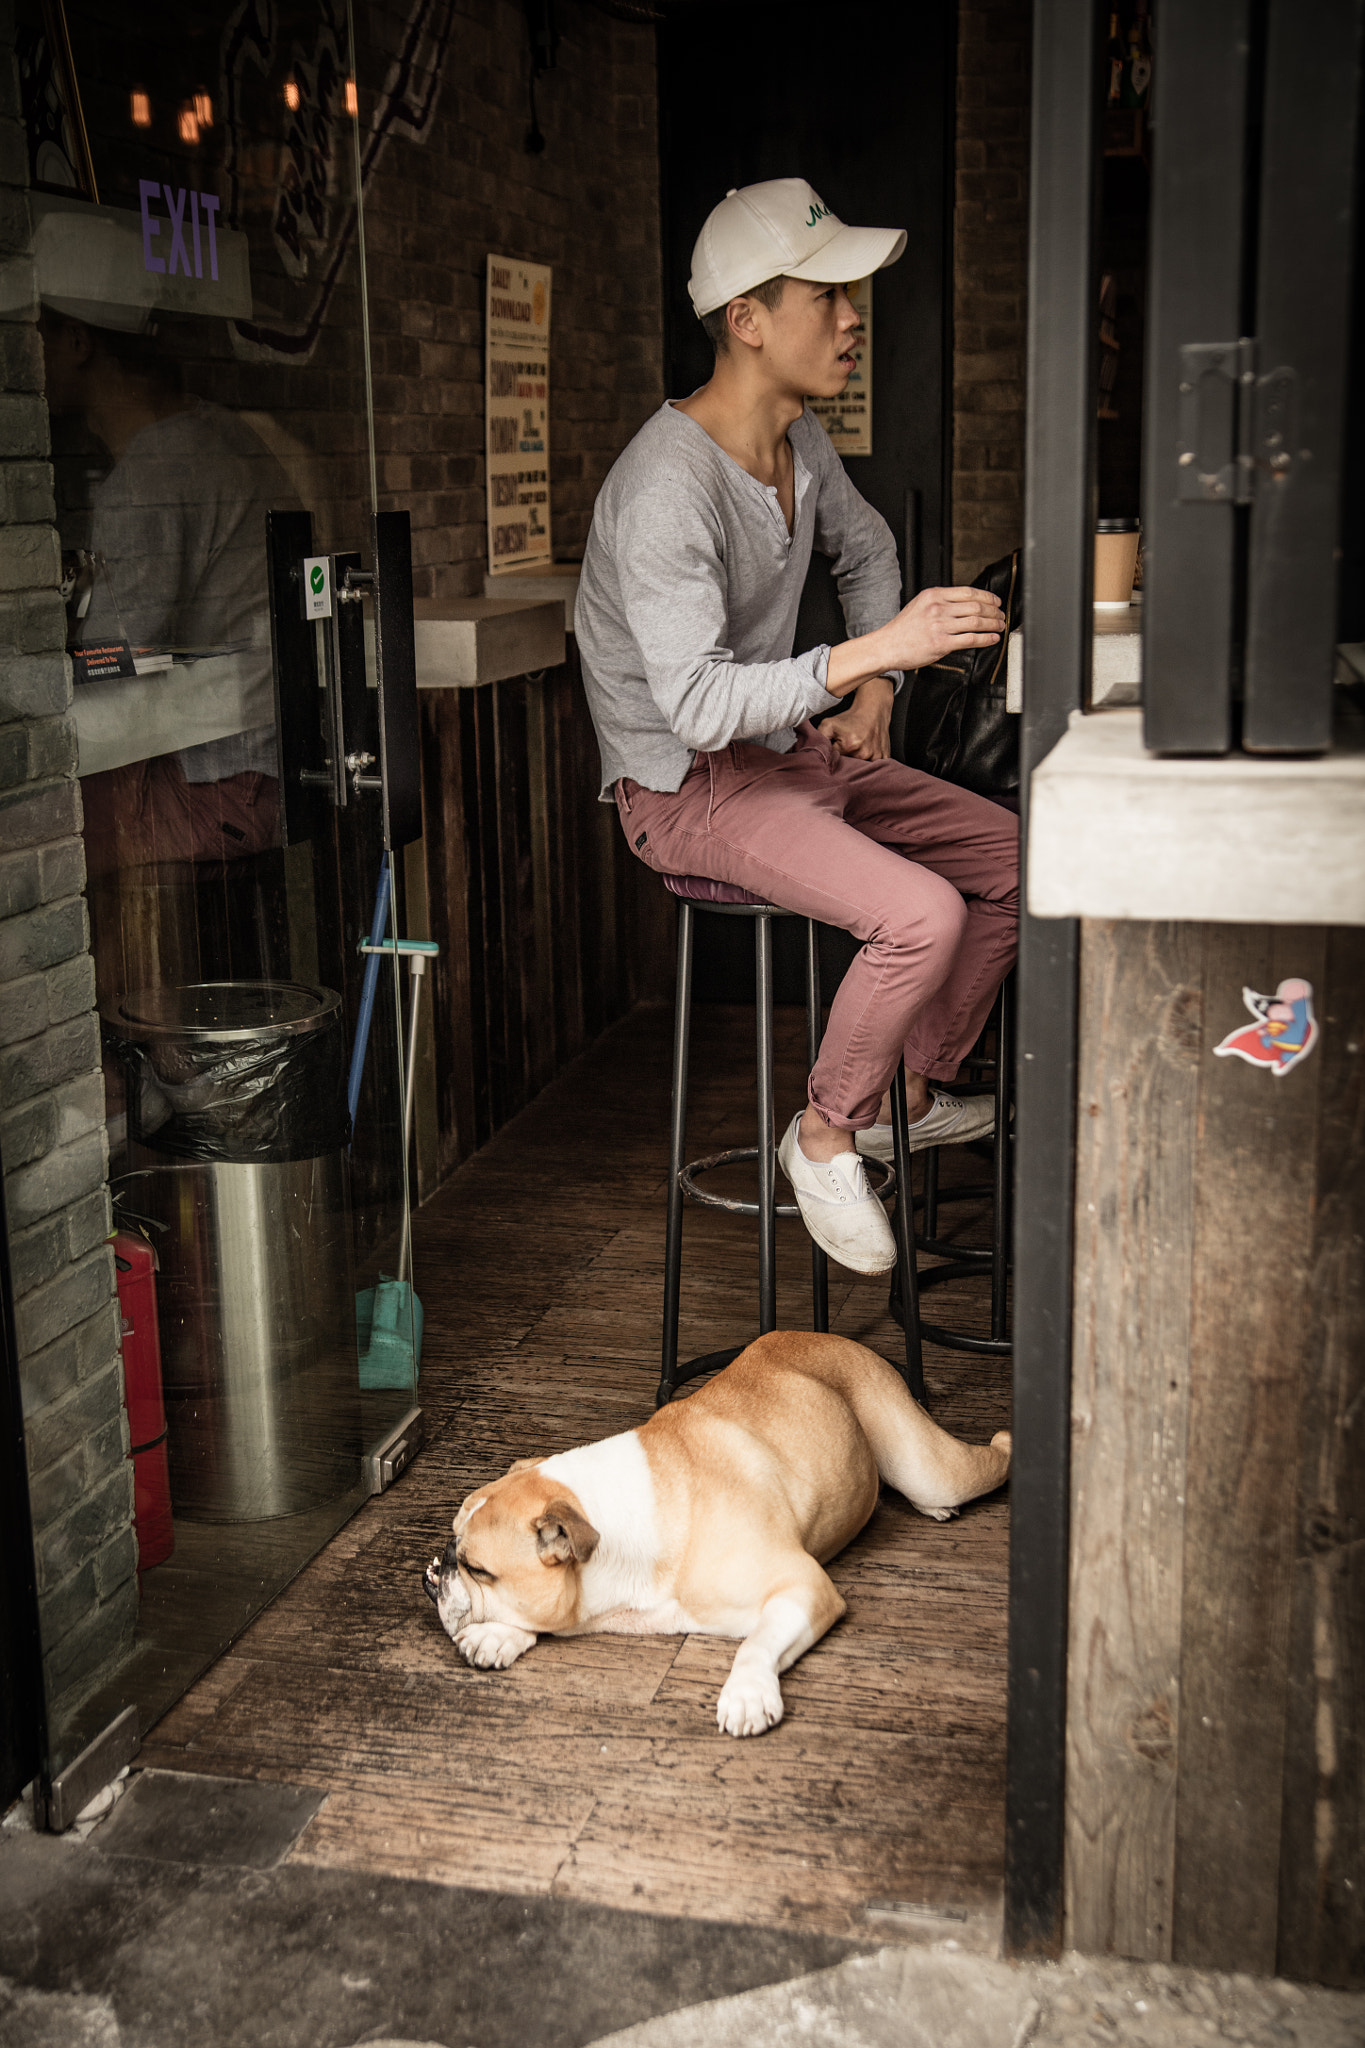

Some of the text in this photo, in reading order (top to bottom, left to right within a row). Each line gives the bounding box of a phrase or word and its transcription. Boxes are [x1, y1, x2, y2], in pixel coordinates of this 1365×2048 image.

[139, 179, 220, 281] EXIT
[491, 296, 532, 322] DOWNLOAD
[101, 646, 124, 654] Restaurants
[86, 657, 106, 666] Delivered
[109, 655, 118, 663] You
